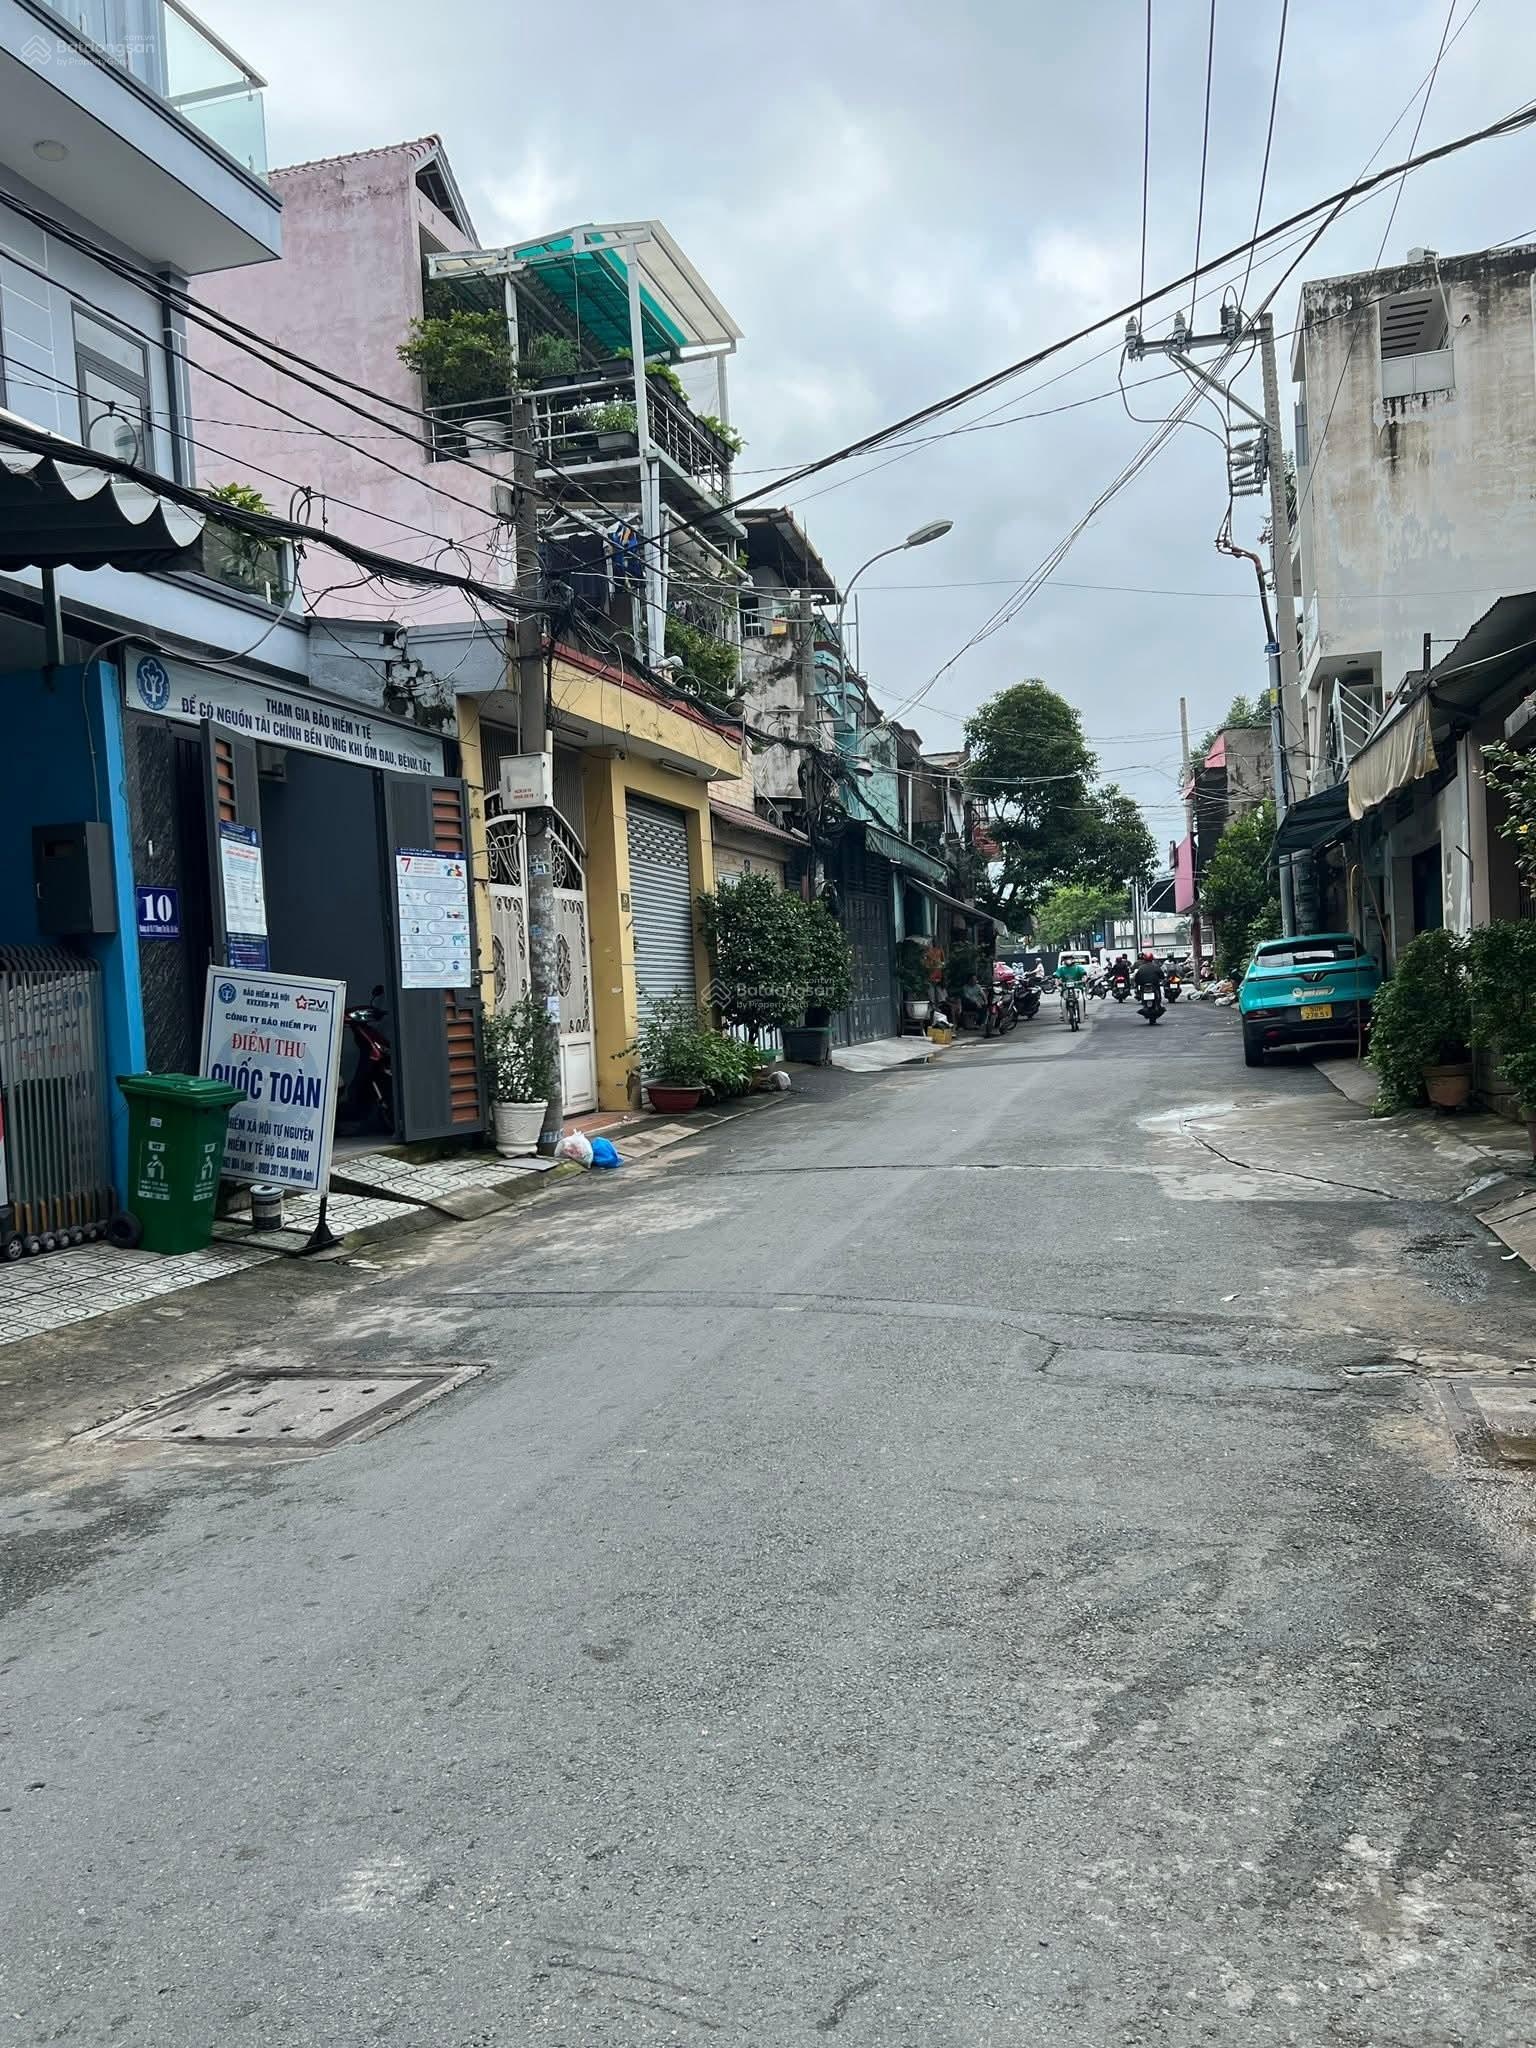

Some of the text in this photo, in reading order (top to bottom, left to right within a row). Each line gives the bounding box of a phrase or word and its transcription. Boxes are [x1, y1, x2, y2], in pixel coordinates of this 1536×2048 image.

[181, 693, 197, 715] ĐỂ
[199, 700, 214, 719] CÓ
[254, 715, 271, 733] TÀI
[273, 721, 302, 741] CHÍNH
[348, 741, 363, 757] KHI
[364, 742, 378, 760] ỐM
[398, 752, 418, 771] BỆNH
[265, 698, 372, 740] THAM GIA BẢO HIỂM Y TẾ
[400, 857, 411, 873] 7
[142, 893, 173, 922] 10
[307, 998, 329, 1009] PVI
[225, 1012, 317, 1032] CÔNG TY BẢO HIỂM PVI
[231, 1028, 307, 1059] ĐIỂM THU
[269, 1068, 322, 1109] TOÀN
[258, 1119, 271, 1137] HỘI
[283, 1126, 315, 1144] NGUYỆN
[227, 1136, 247, 1152] HIỂM
[248, 1141, 255, 1153] Y
[255, 1139, 264, 1154] TẾ
[264, 1142, 276, 1160] HỘ
[276, 1146, 289, 1160] GIA
[291, 1146, 310, 1163] ĐÌNH
